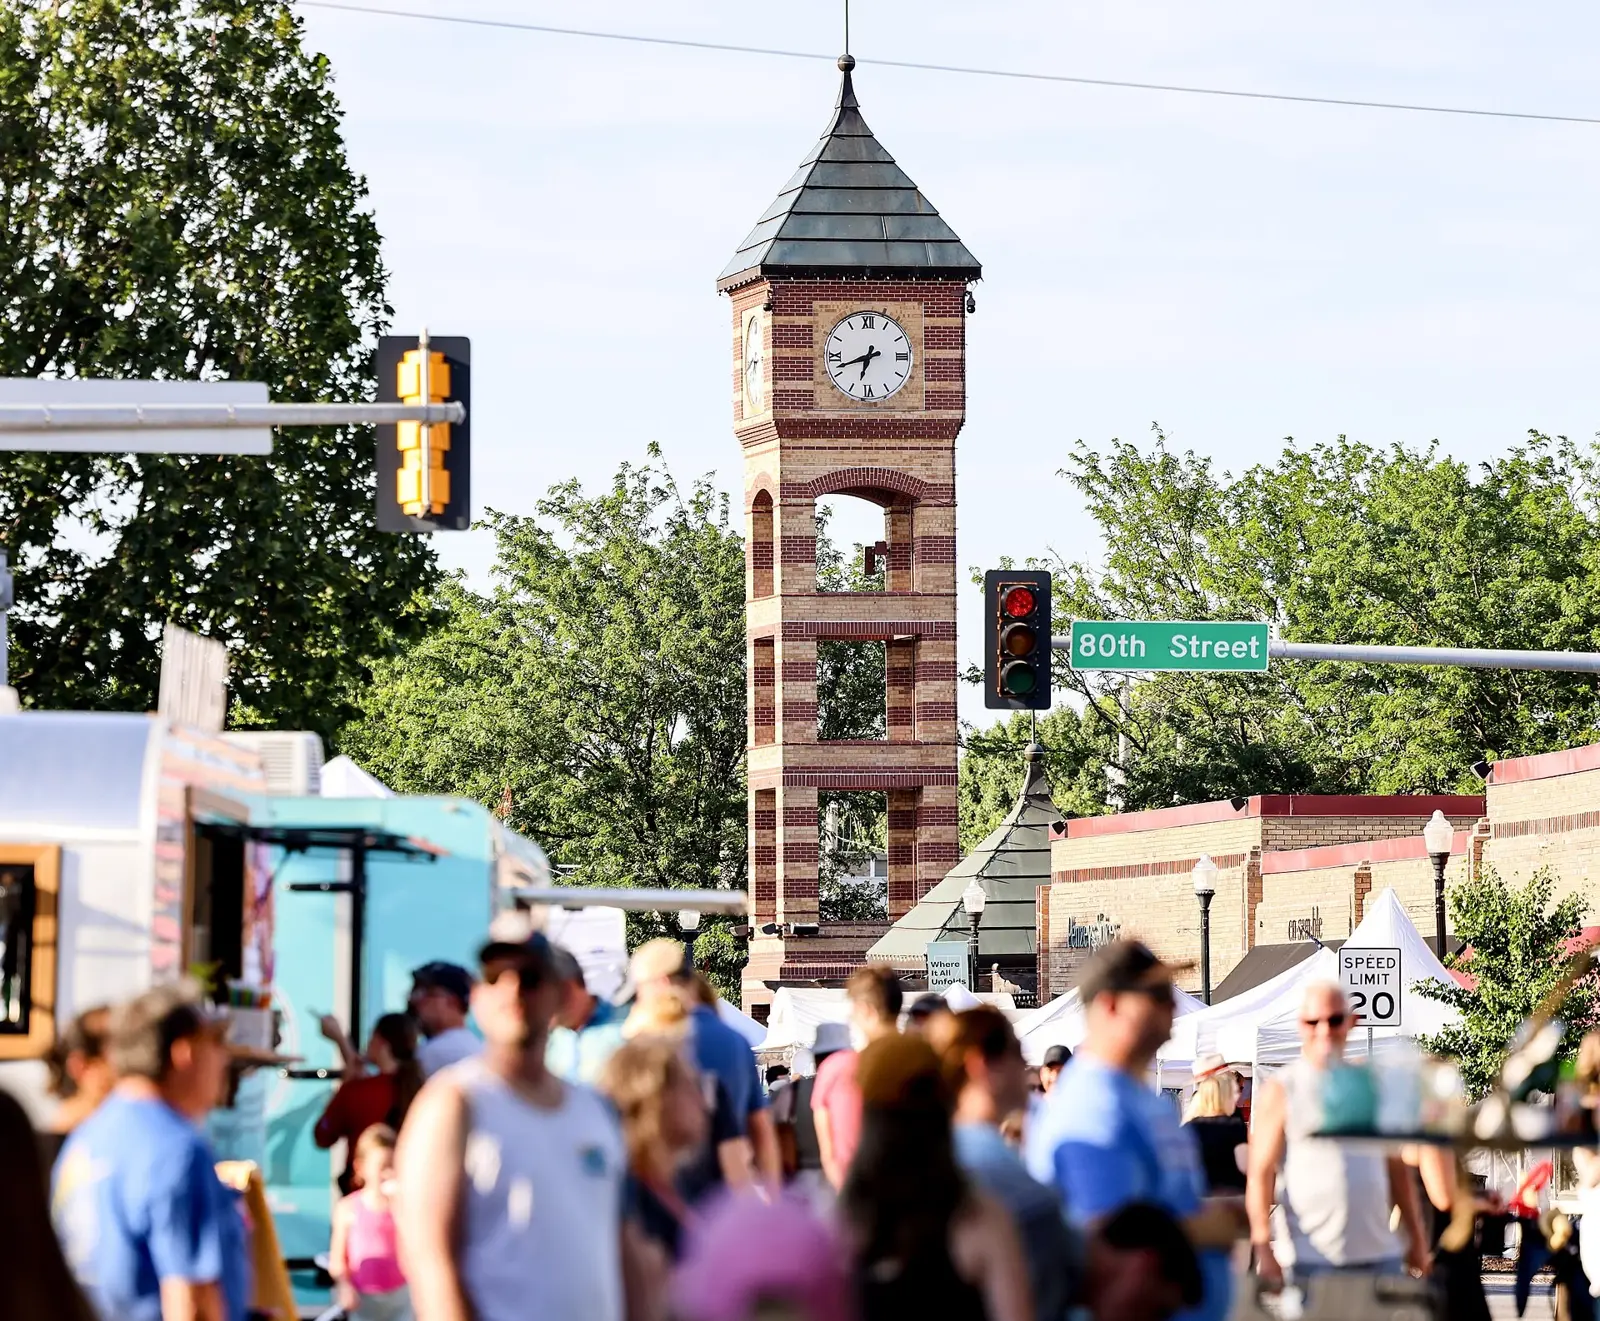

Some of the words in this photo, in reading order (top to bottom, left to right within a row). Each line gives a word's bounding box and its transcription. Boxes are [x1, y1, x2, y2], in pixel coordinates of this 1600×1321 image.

[1079, 633, 1146, 657] 80th
[1169, 634, 1260, 659] Street
[1344, 957, 1396, 969] SPEED
[1350, 973, 1390, 985] LIMIT
[1348, 991, 1395, 1020] 20
